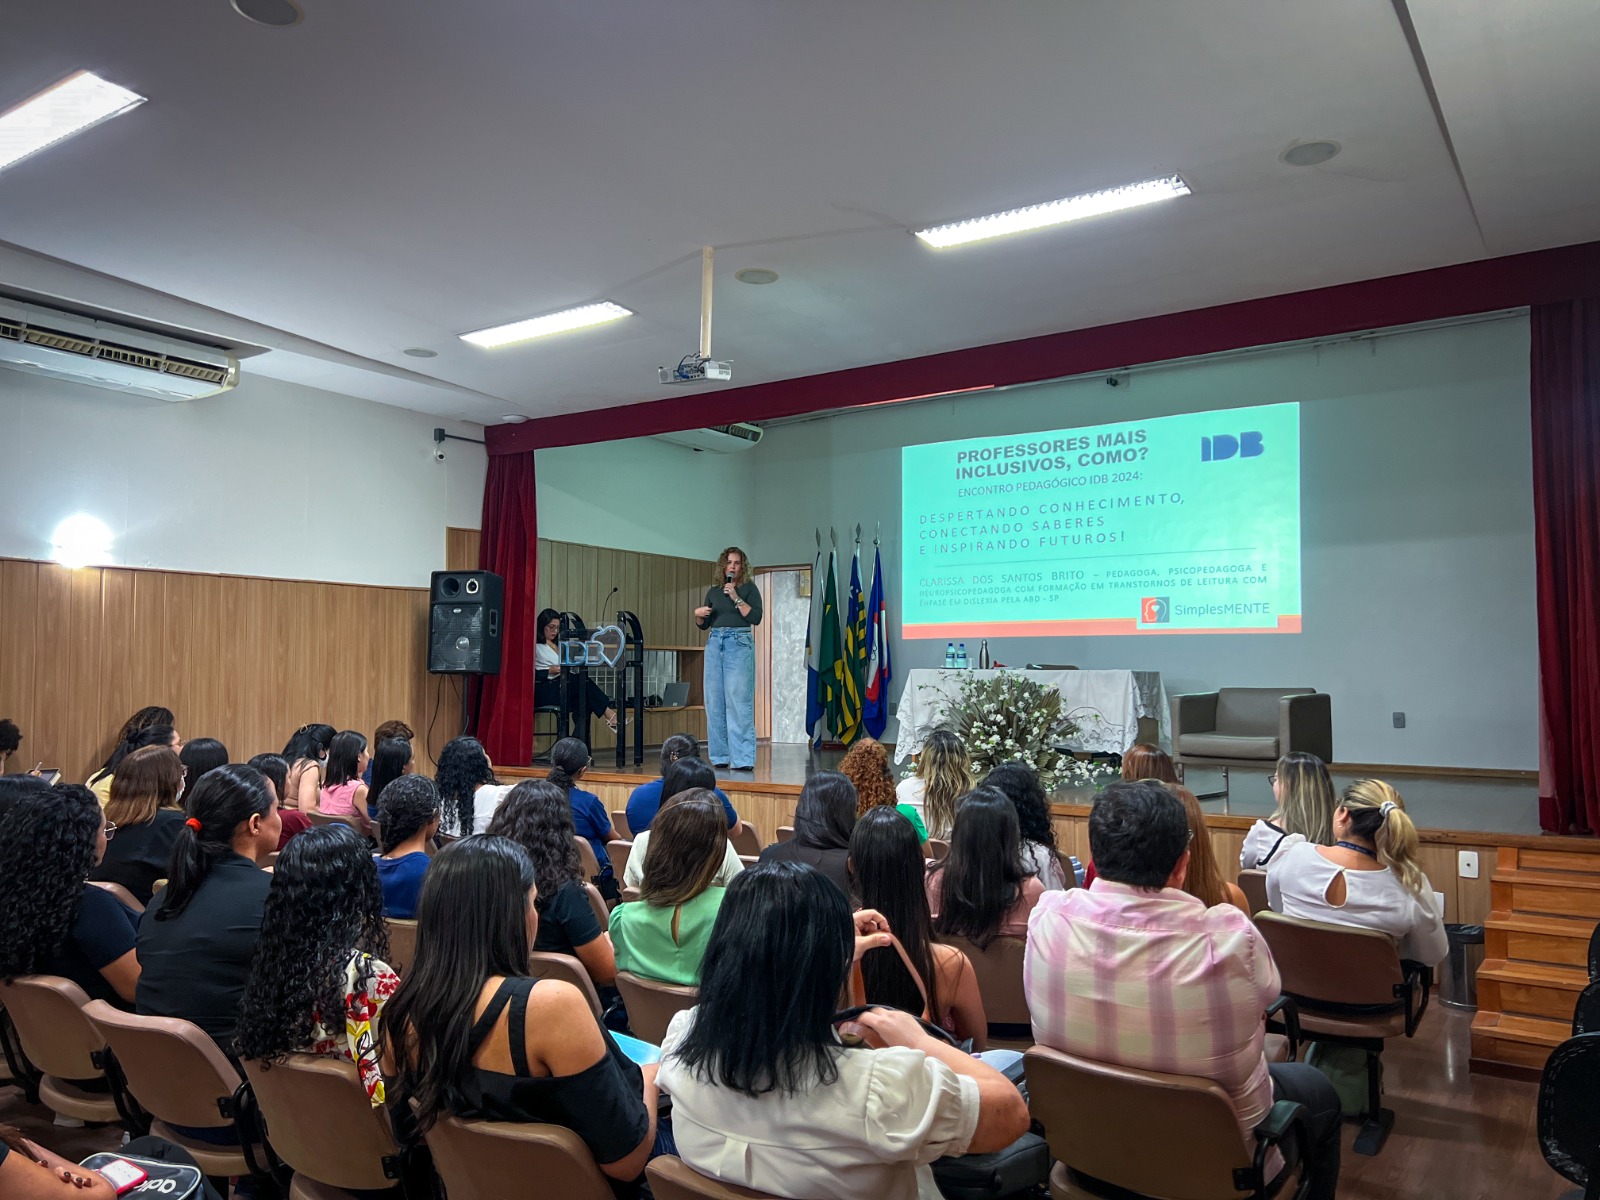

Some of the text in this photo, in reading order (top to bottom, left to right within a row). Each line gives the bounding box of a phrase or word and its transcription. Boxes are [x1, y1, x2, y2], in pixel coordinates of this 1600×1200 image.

[957, 429, 1147, 464] PROFESSORES MAIS
[1201, 430, 1265, 462] IDB
[955, 447, 1149, 480] INCLUSIVOS, COMO?
[958, 471, 1143, 497] ENCONTRO PEDAGÓGICO IDB 2024:
[919, 492, 1185, 525] DESPERTANDO CONHECIMENTO,
[919, 516, 1105, 540] CONECTANDO SABERES
[919, 531, 1126, 555] E INSPIRANDO FUTUROS!
[919, 577, 964, 587] CLARISSA
[972, 575, 993, 585] DOS
[1001, 572, 1043, 584] SANTOS
[1051, 570, 1084, 581] BRITO
[1106, 568, 1160, 578] PEDAGOGA,
[1168, 564, 1252, 576] PSICOPEDAGOGA
[1261, 563, 1267, 572] E
[919, 576, 1267, 598] NEUROPSICOPEDAGOGA COM FORMAÇÃO EM TRANSTORNOS DE LEITURA COM
[949, 598, 961, 606] EM
[963, 597, 998, 605] DISLEXIA
[1001, 596, 1021, 604] PELA
[1023, 595, 1041, 603] ABD
[1049, 594, 1059, 602] SP
[1174, 602, 1271, 617] SimplesMENTE
